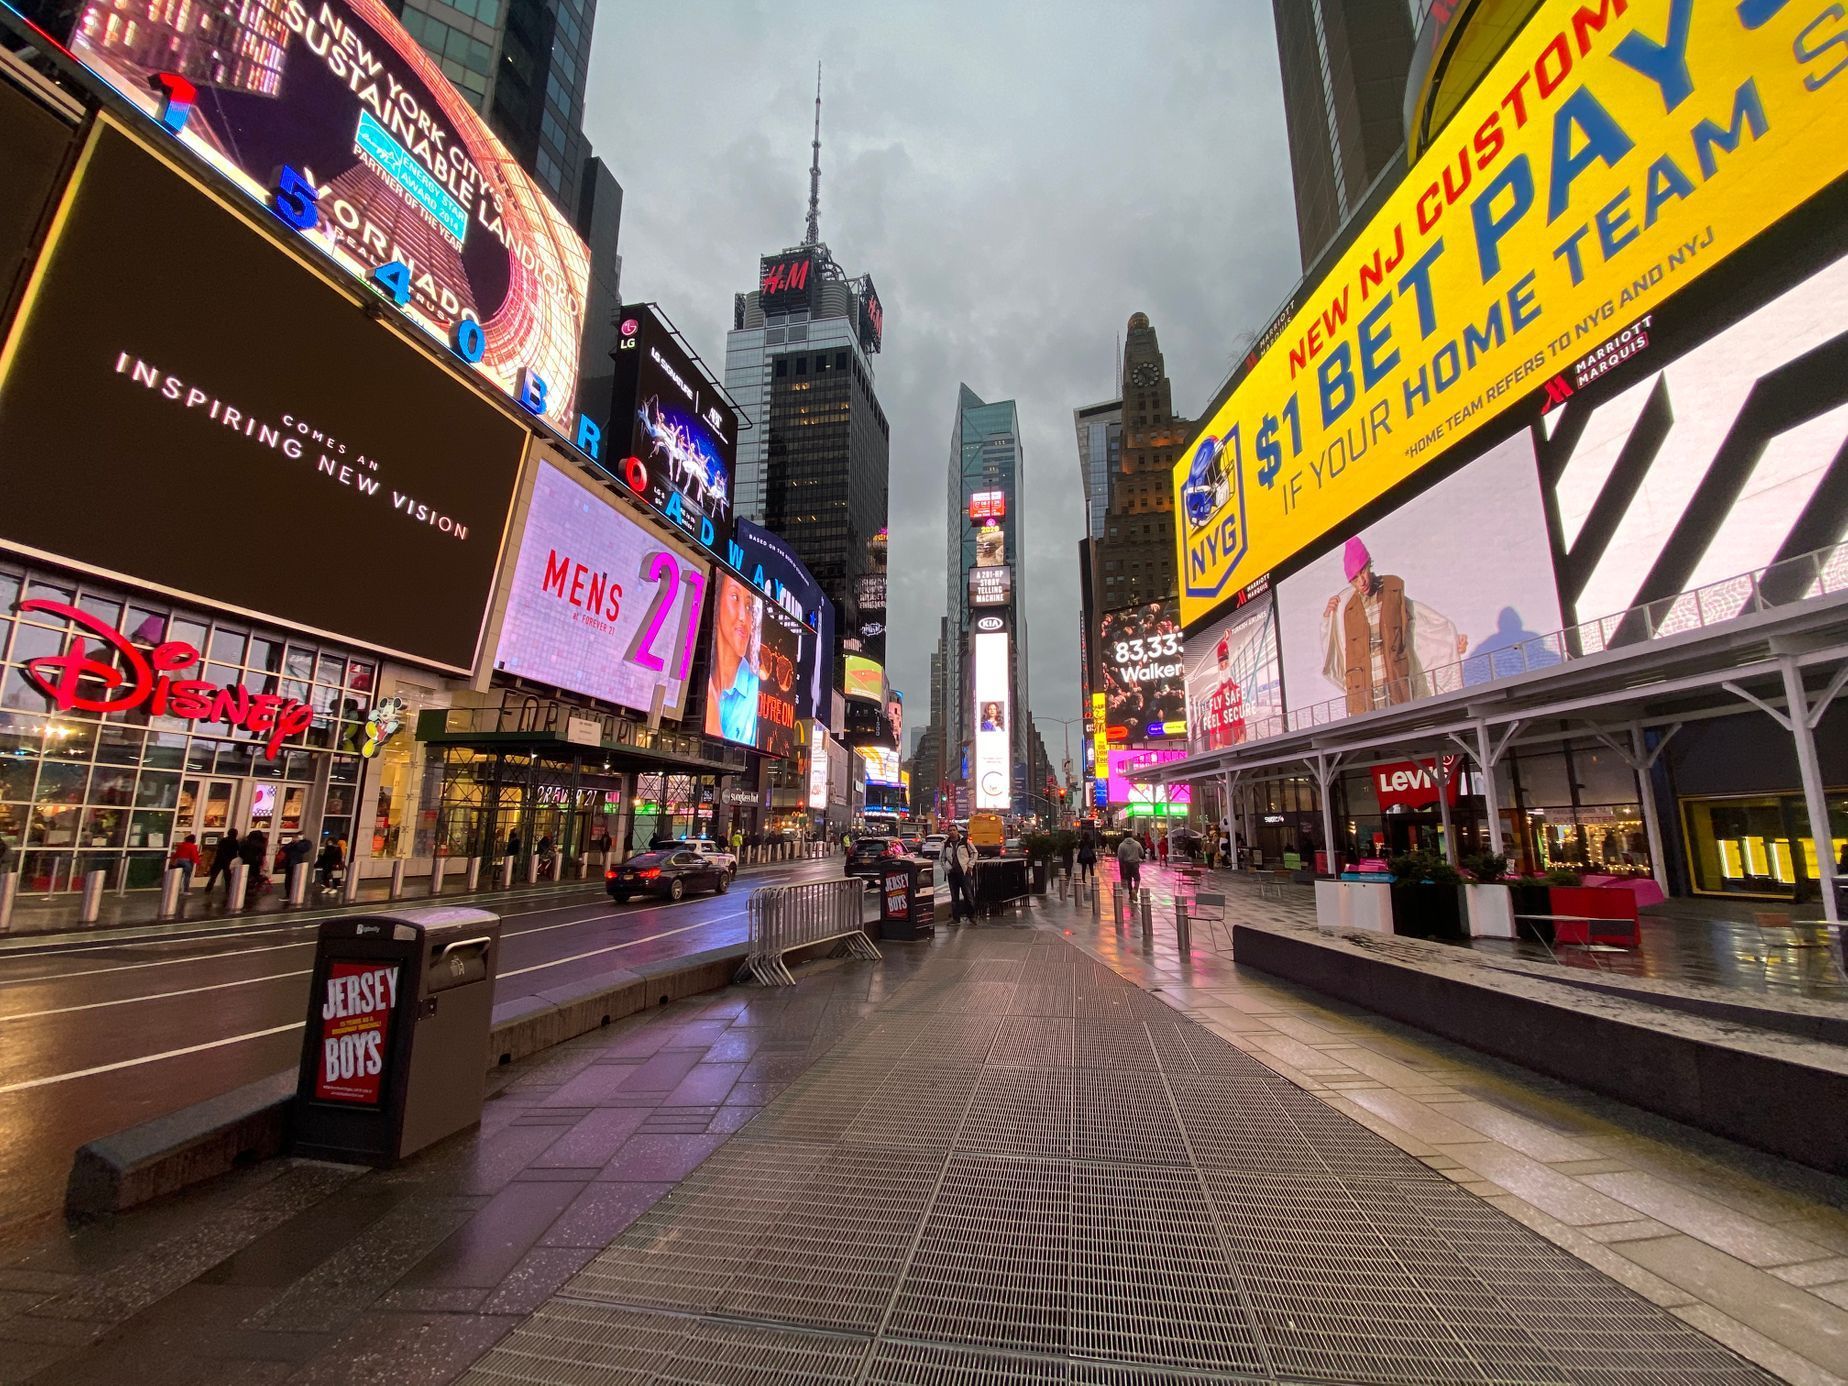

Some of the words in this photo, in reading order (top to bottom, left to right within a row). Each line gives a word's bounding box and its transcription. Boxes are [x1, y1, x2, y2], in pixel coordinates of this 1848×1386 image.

[319, 2, 384, 77] NEW
[387, 72, 446, 151] YORK
[449, 146, 504, 213] CITY'S
[284, 0, 474, 210] SUSTAINABLE
[478, 199, 578, 317] LANDLORD
[353, 143, 403, 198] PARTNER
[419, 207, 439, 230] THE
[439, 225, 464, 254] YEAR
[401, 171, 438, 210] AWARD
[439, 209, 459, 231] 2014
[402, 157, 441, 198] ENERGY
[442, 196, 466, 220] STAR
[762, 260, 810, 295] H&M
[1282, 469, 1303, 516] IF
[1309, 398, 1393, 490] YOUR
[1401, 268, 1543, 420] HOME
[1552, 76, 1770, 289] TEAM
[1288, 283, 1350, 381] NEW
[1358, 221, 1406, 303] NJ
[620, 337, 636, 350] LG
[1259, 299, 1296, 349] MARRIOTT
[1446, 396, 1485, 432] TEAM
[1486, 350, 1546, 400] REFERS
[1547, 330, 1572, 358] TO
[1575, 300, 1615, 341] NYG
[1619, 263, 1664, 309] AND
[1668, 224, 1716, 273] NYJ
[1574, 314, 1653, 375] MARRIOTT
[1255, 389, 1303, 491] $1
[1316, 234, 1446, 432] BET
[1577, 335, 1648, 388] MARQUIS
[115, 350, 304, 460] INSPIRING
[317, 453, 381, 497] NEW
[391, 490, 470, 541] VISION
[282, 414, 347, 455] COMES
[356, 454, 380, 472] AN
[748, 533, 768, 547] BASED
[1191, 513, 1237, 583] NYG
[542, 548, 623, 622] MENS
[976, 593, 1004, 603] MACHINE
[977, 586, 1003, 595] TELLING
[1246, 572, 1270, 592] MARRIOTT
[1247, 582, 1268, 600] MARQUIS
[582, 614, 607, 633] FOREVER
[630, 552, 705, 682] 21
[781, 701, 795, 730] ON
[1203, 710, 1221, 731] FEEL
[1223, 700, 1257, 725] SECURE
[1209, 693, 1223, 713] FLY
[1224, 686, 1247, 706] SAFE
[885, 873, 909, 892] JERSEY
[887, 895, 908, 912] BOYS
[322, 966, 400, 1021] JERSEY
[325, 1030, 382, 1082] BOYS
